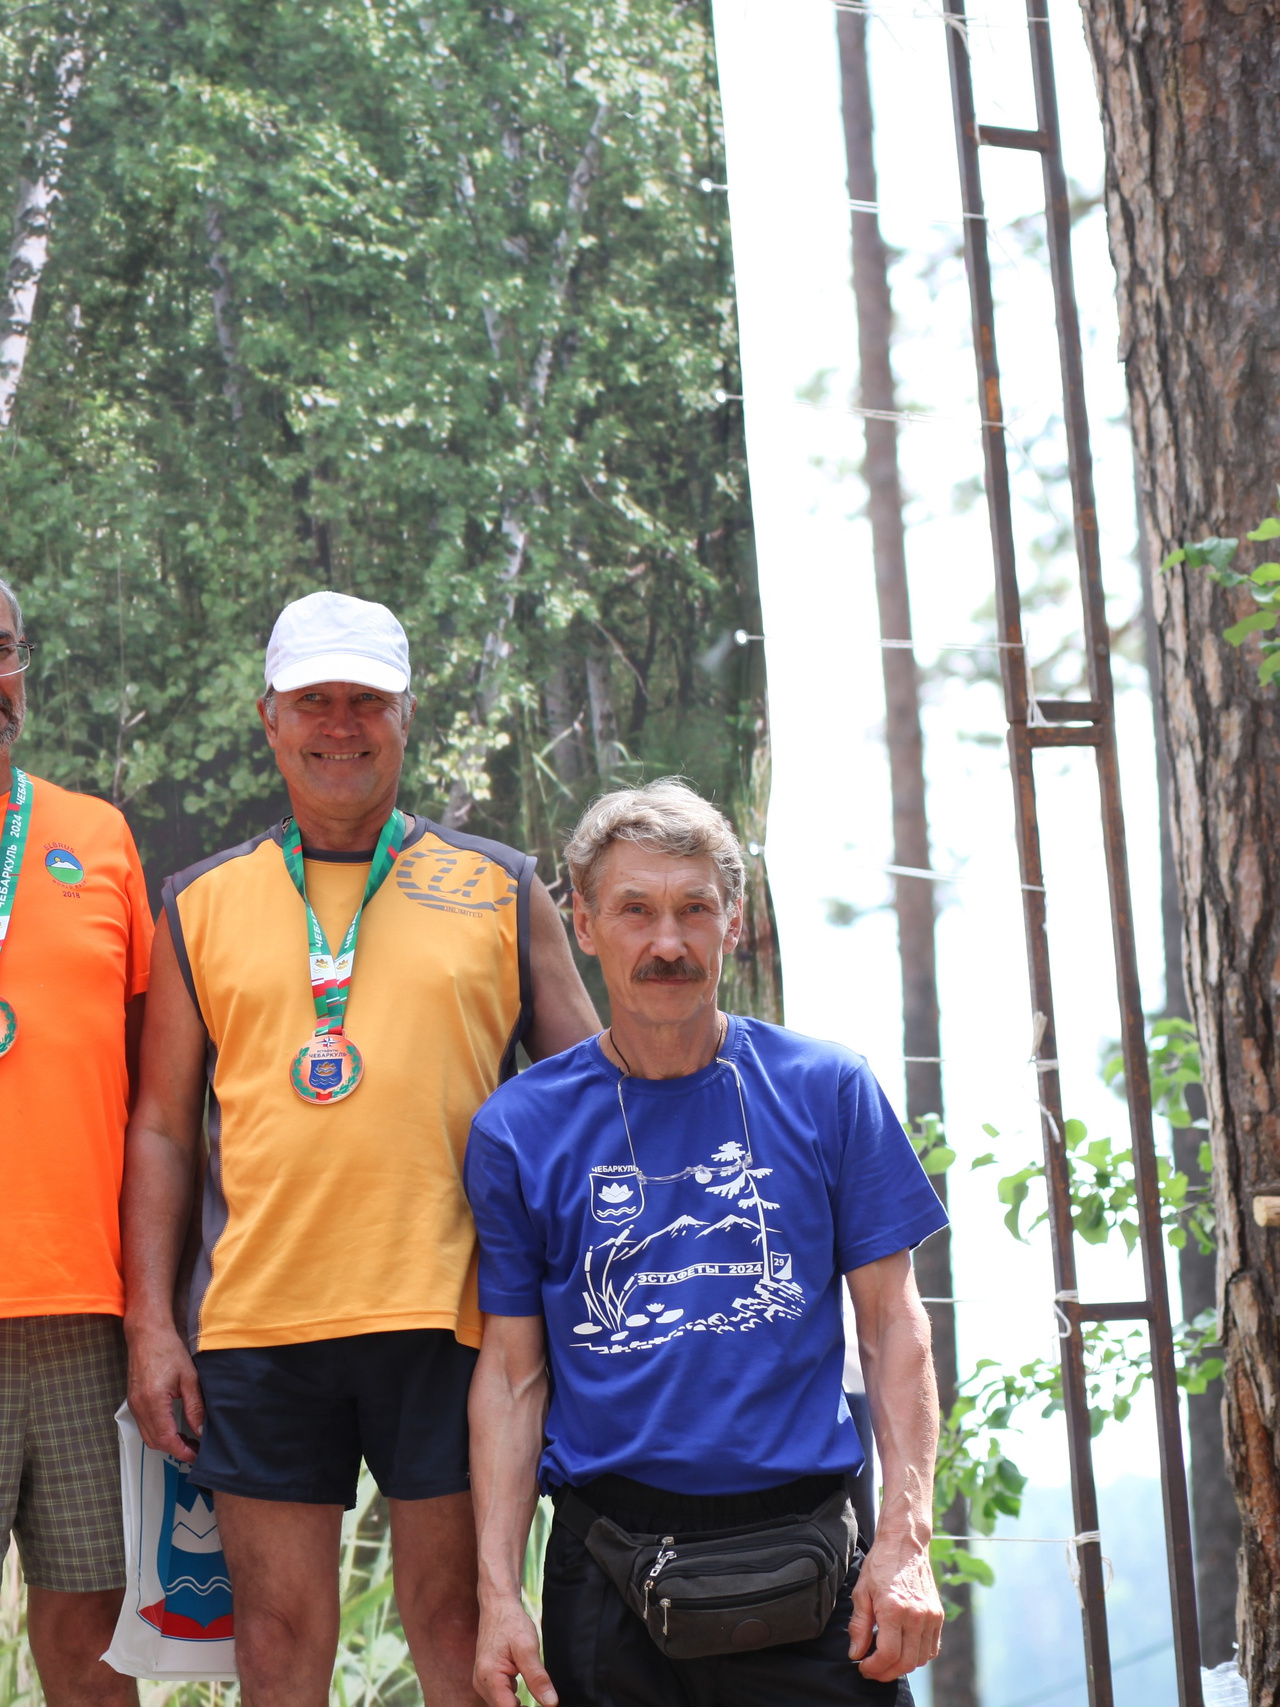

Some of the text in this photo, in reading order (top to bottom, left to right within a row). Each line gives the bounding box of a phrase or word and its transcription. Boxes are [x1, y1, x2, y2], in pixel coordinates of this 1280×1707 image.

[10, 814, 23, 838] 2024
[43, 841, 75, 853] ELBRUS
[62, 890, 81, 899] 2018
[591, 1165, 639, 1173] ЧЕБАРКУЛЬ
[773, 1257, 785, 1266] 29
[637, 1263, 763, 1283] ЭСТАФЕТЫ 2024
